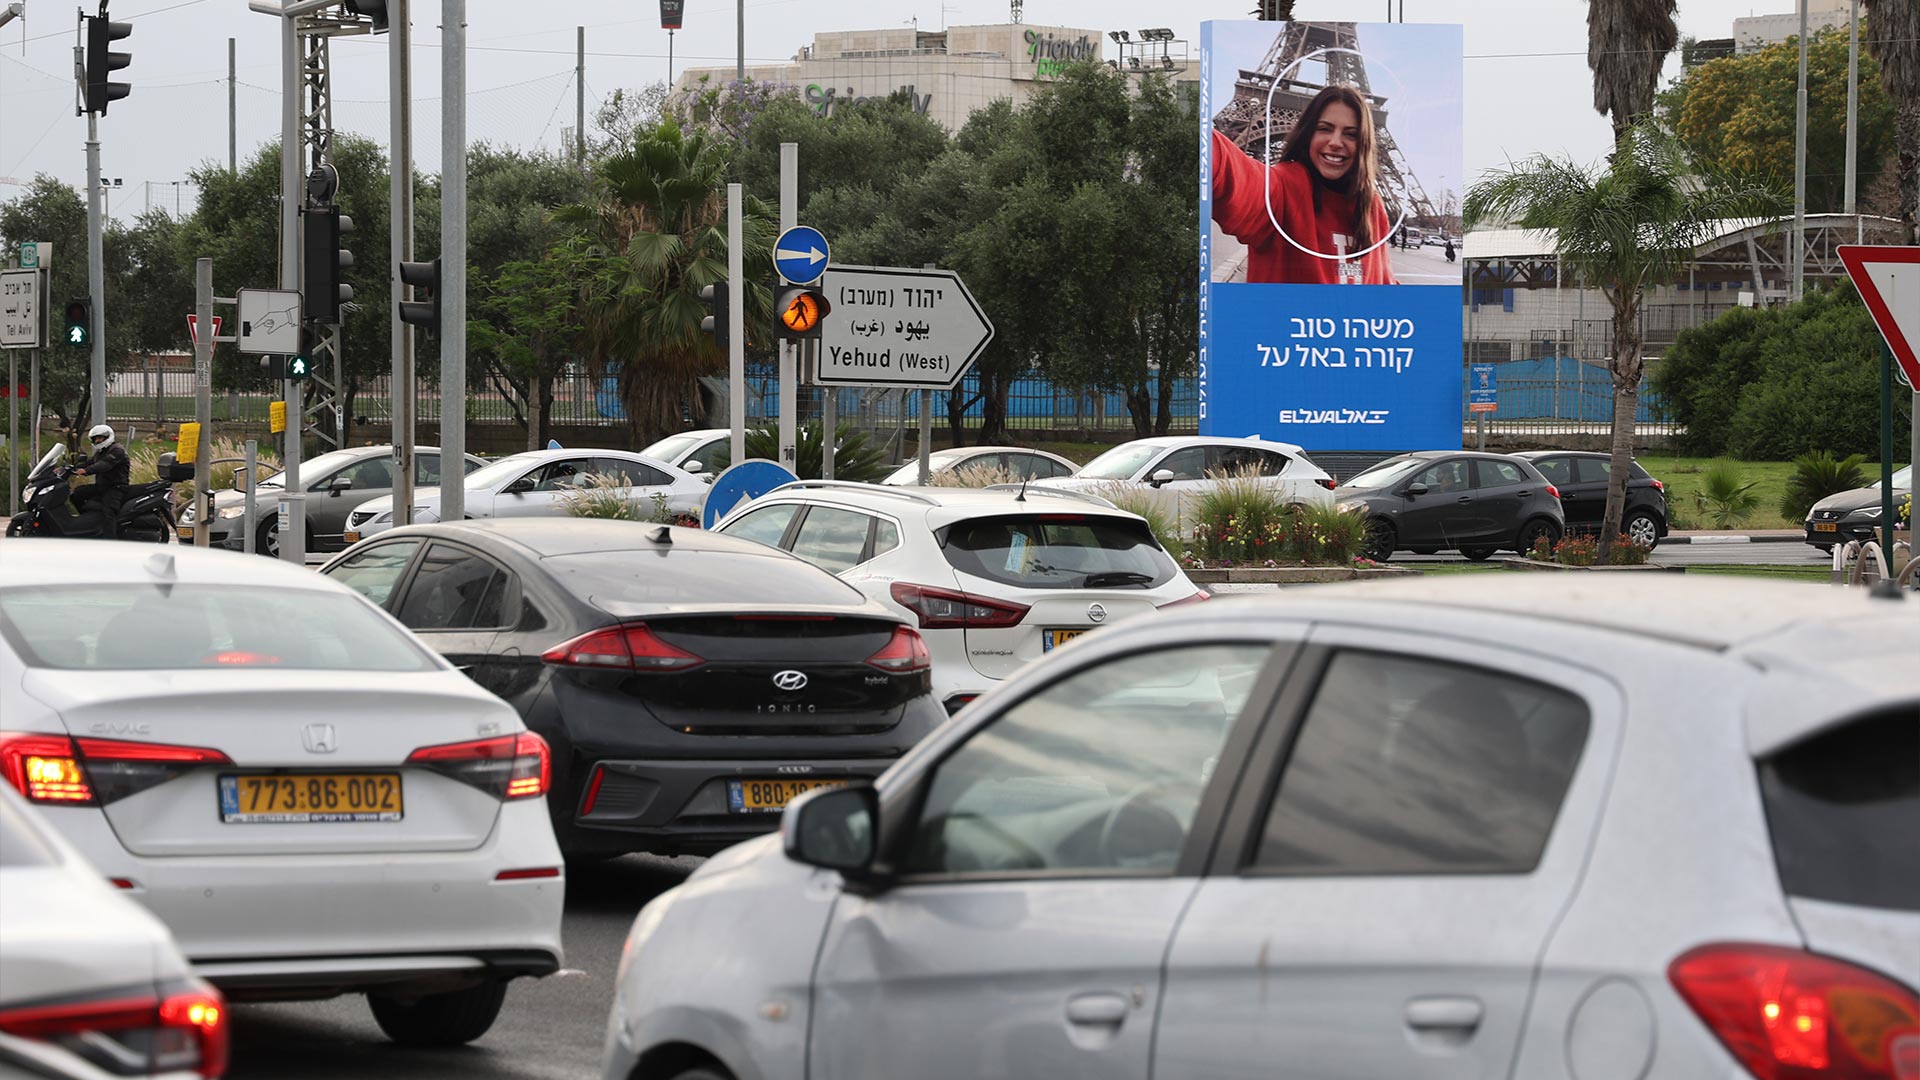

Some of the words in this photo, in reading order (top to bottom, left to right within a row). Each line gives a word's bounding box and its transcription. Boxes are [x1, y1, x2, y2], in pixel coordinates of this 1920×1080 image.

[5, 283, 20, 295] אביב
[22, 281, 31, 294] תל
[840, 286, 895, 308] (מערב)
[903, 288, 943, 308] יהוד
[6, 324, 16, 336] Tel
[18, 323, 32, 335] Aviv
[851, 320, 885, 336] (غرب)
[895, 319, 930, 340] يهود
[1290, 318, 1336, 338] טוב
[1343, 318, 1415, 339] משהו
[830, 346, 890, 368] Yehud
[899, 353, 950, 373] (West)
[1256, 344, 1291, 367] על
[1296, 344, 1347, 368] באל
[1354, 347, 1414, 374] קורה
